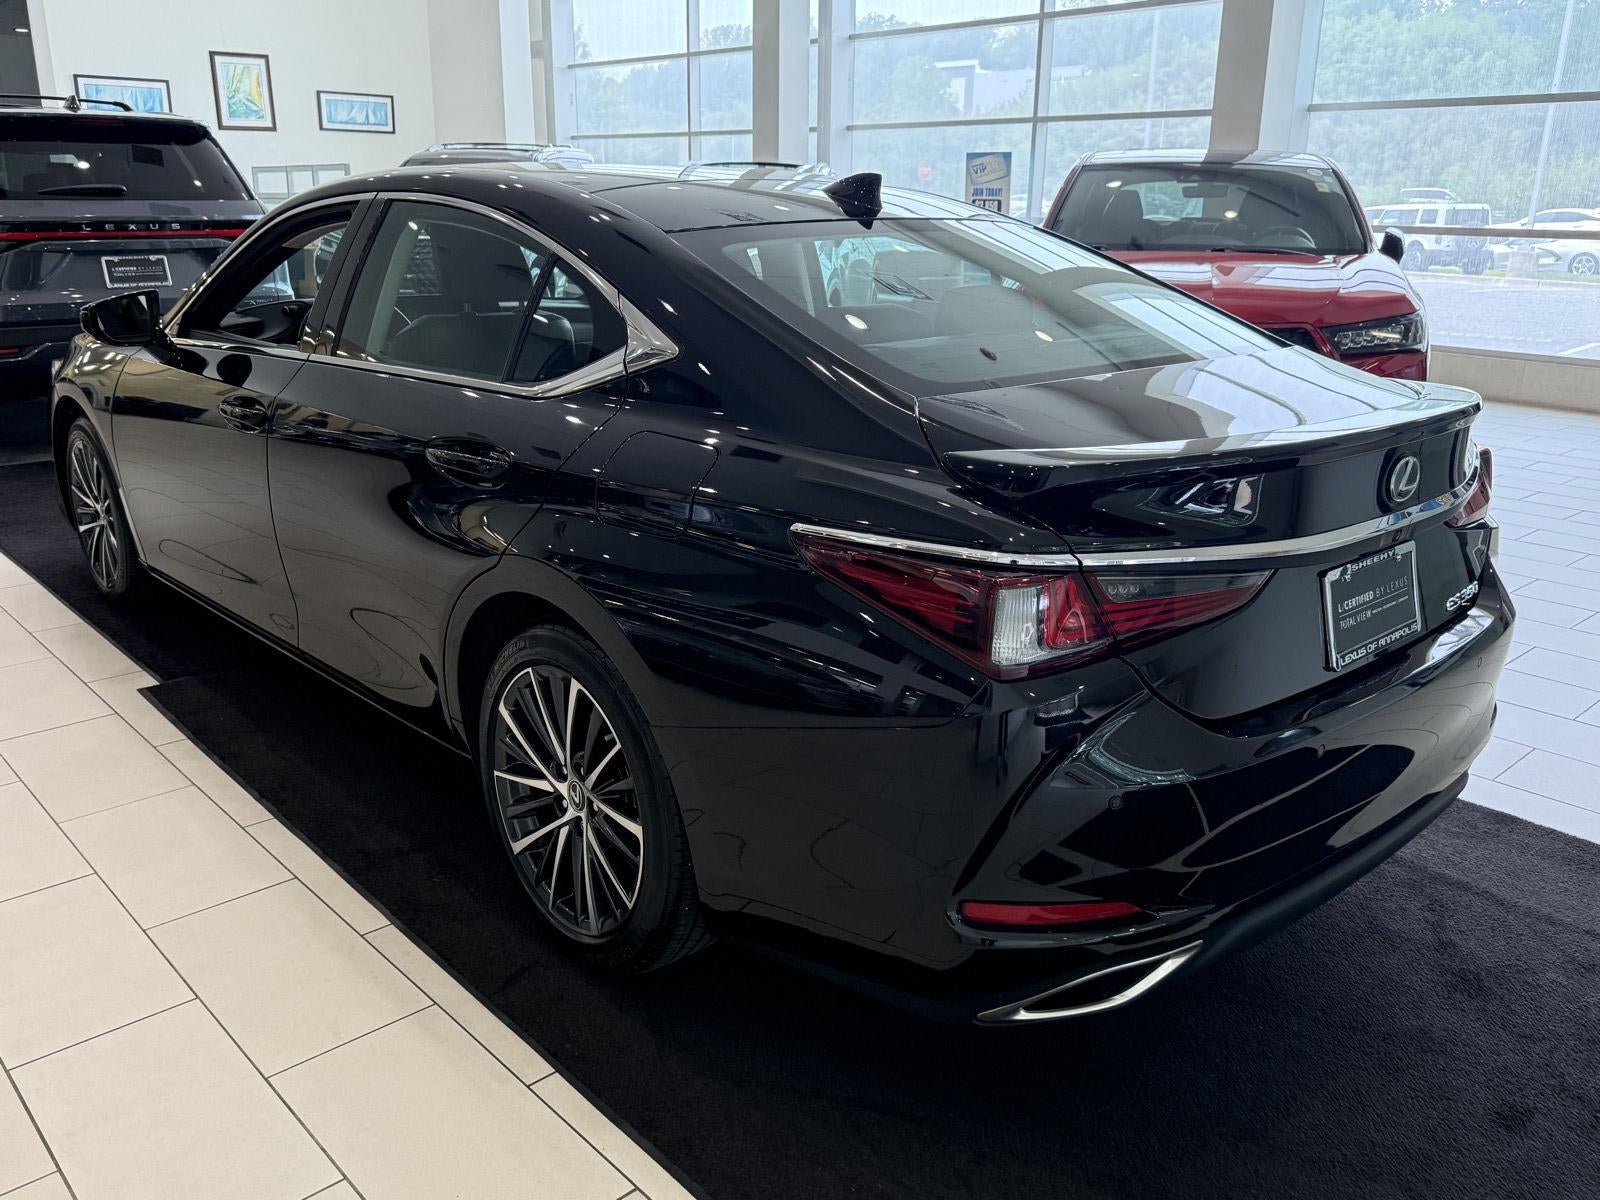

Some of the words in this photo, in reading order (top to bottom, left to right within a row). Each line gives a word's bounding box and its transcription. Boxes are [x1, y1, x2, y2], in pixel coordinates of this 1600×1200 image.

[973, 165, 987, 175] VIP
[972, 187, 983, 197] JOIN
[82, 223, 181, 231] LEXUS
[1351, 549, 1395, 571] SHEEHY
[1376, 586, 1385, 597] BY
[1386, 576, 1408, 593] LEXUS
[1340, 614, 1356, 629] TOTAL
[1357, 609, 1371, 622] VIEW
[1340, 647, 1366, 666] LEXUS
[1367, 642, 1377, 652] OF
[1379, 622, 1418, 648] ANNAPOLIS
